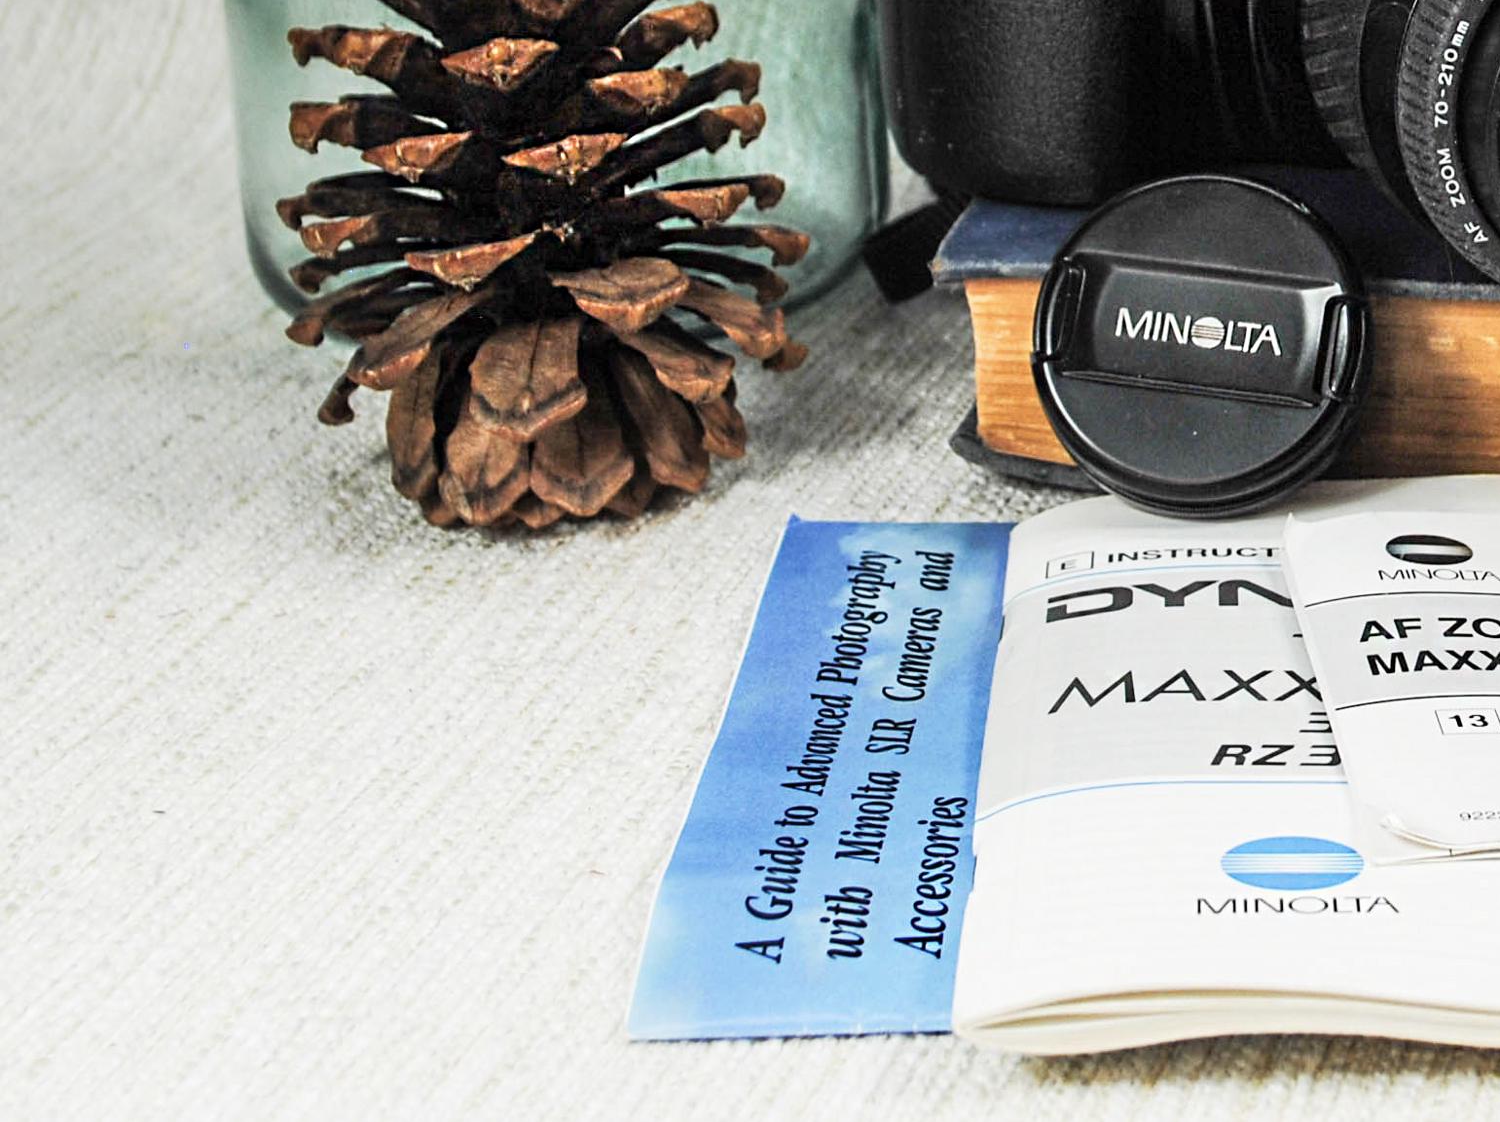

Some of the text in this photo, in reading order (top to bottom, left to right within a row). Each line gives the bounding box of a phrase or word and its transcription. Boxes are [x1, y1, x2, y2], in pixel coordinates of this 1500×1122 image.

[1436, 147, 1466, 208] ZOOM
[1463, 221, 1489, 245] AF
[1114, 306, 1283, 357] MINOLTA
[1059, 559, 1077, 572] E
[1358, 617, 1423, 643] AF
[1447, 714, 1490, 730] 13
[734, 549, 903, 964] A Guide to Advanced Photography
[816, 550, 955, 961] with Minolta SLR Cameras and
[892, 796, 969, 960] Accessories
[1196, 894, 1401, 916] MINOLTA
